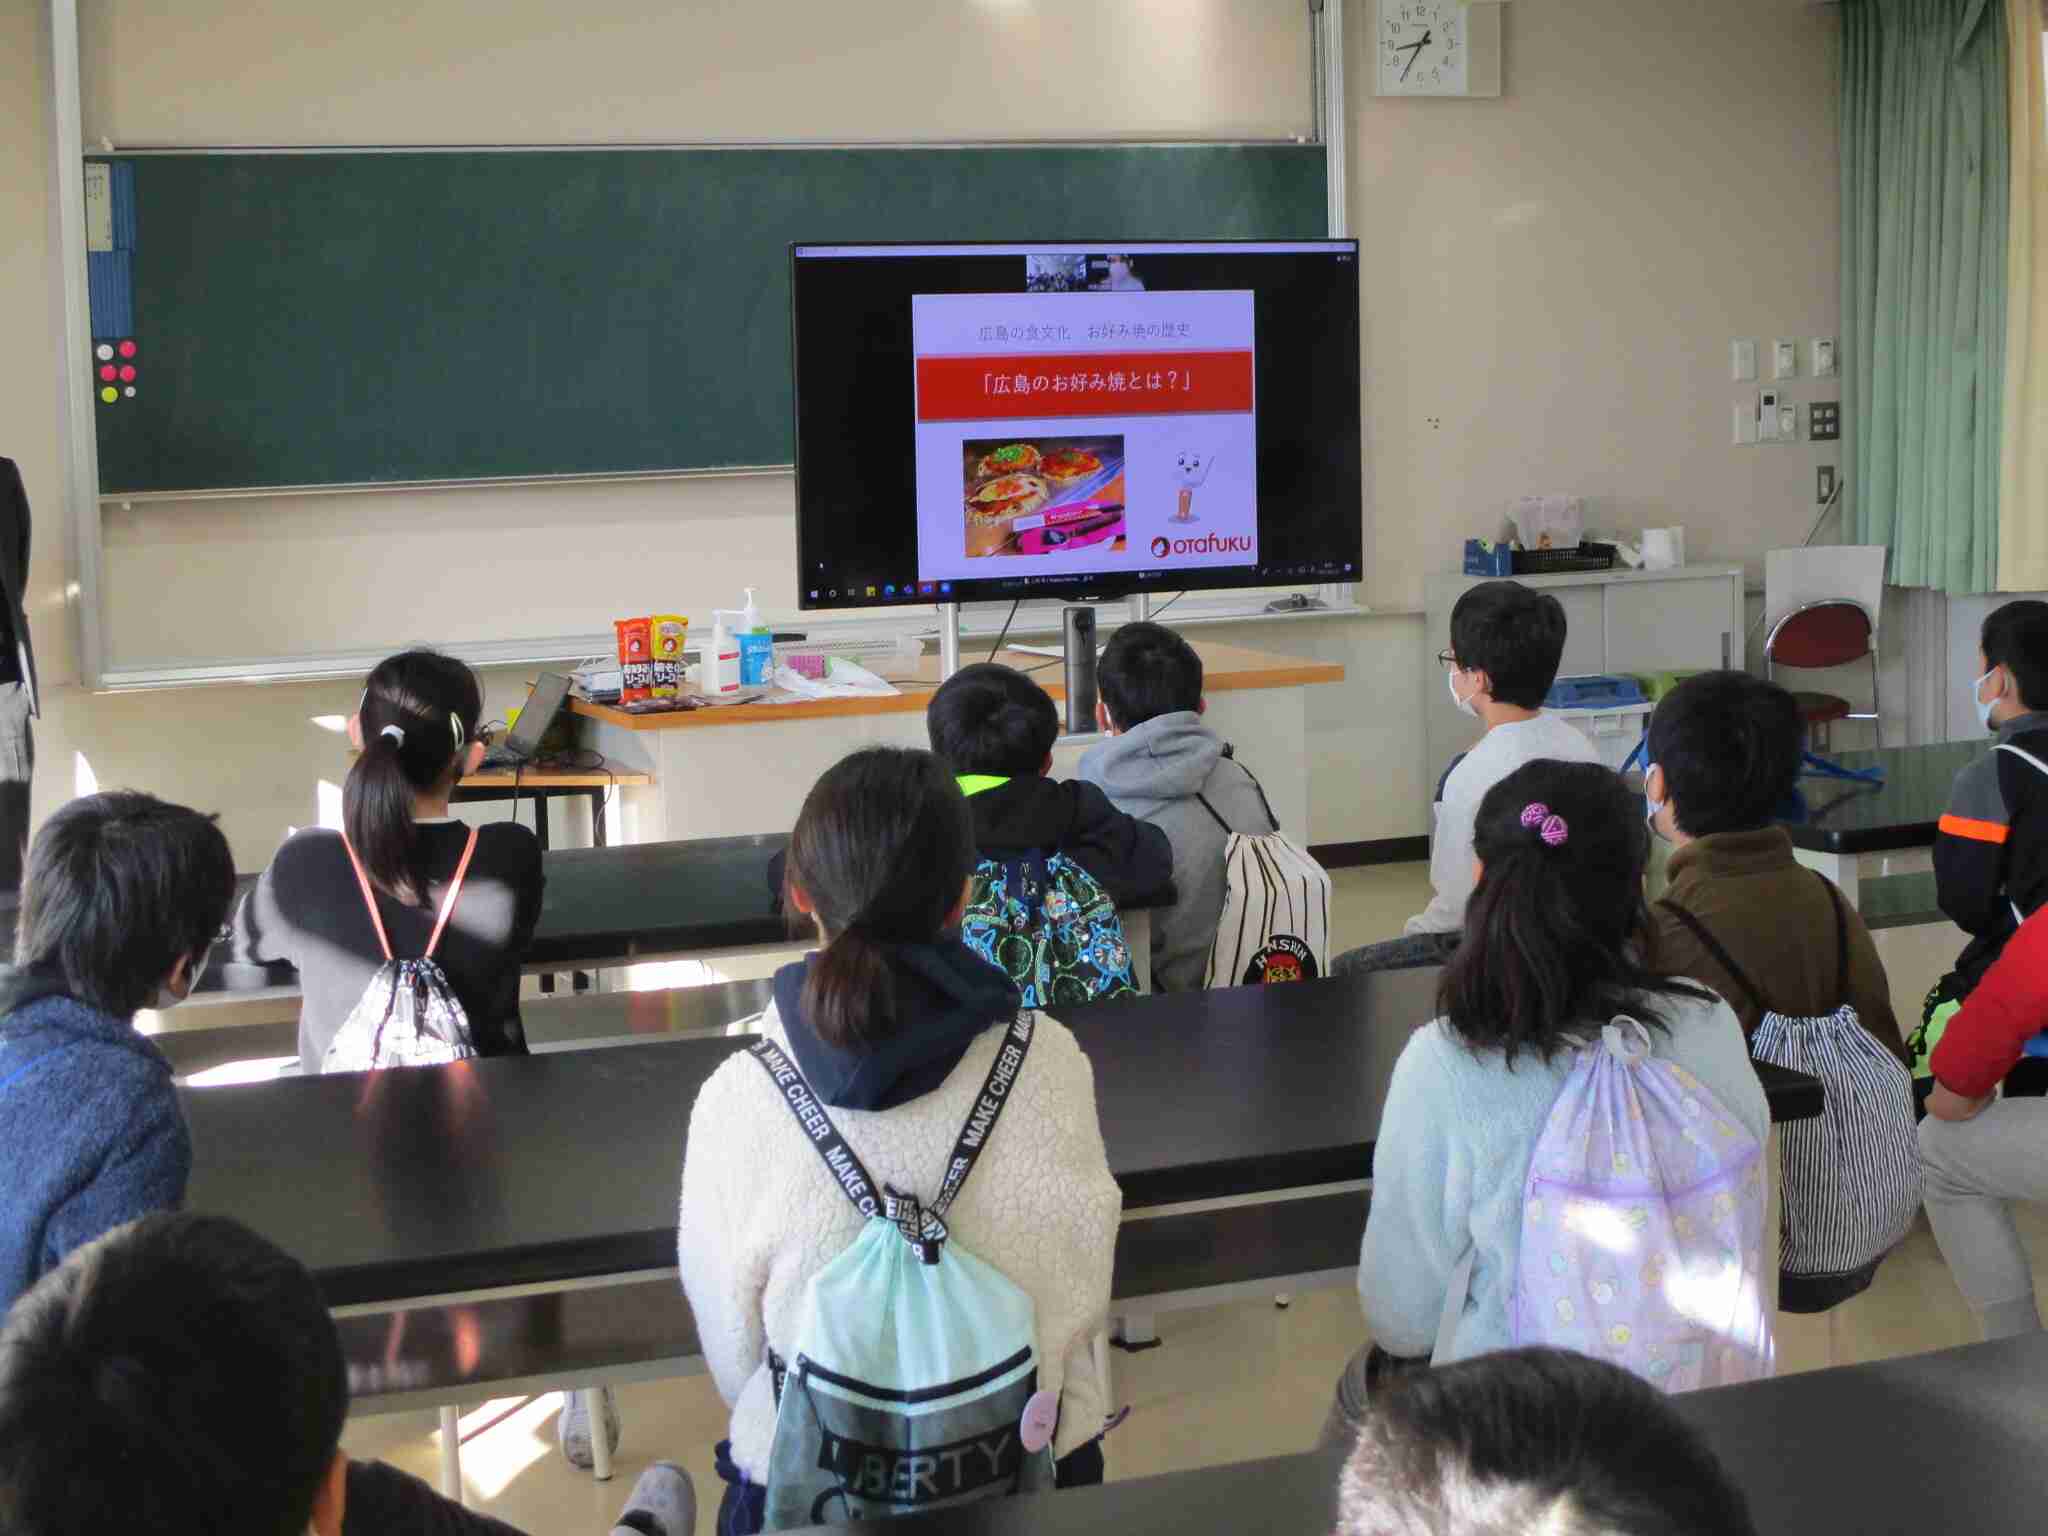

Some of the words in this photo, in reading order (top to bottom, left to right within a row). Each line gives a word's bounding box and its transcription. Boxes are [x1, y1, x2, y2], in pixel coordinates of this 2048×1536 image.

[762, 1048, 798, 1087] MAKE
[787, 1083, 829, 1142] CHEER
[826, 1144, 865, 1199] MAKE
[962, 1089, 1000, 1150] MAKE
[989, 1043, 1023, 1097] CHEER
